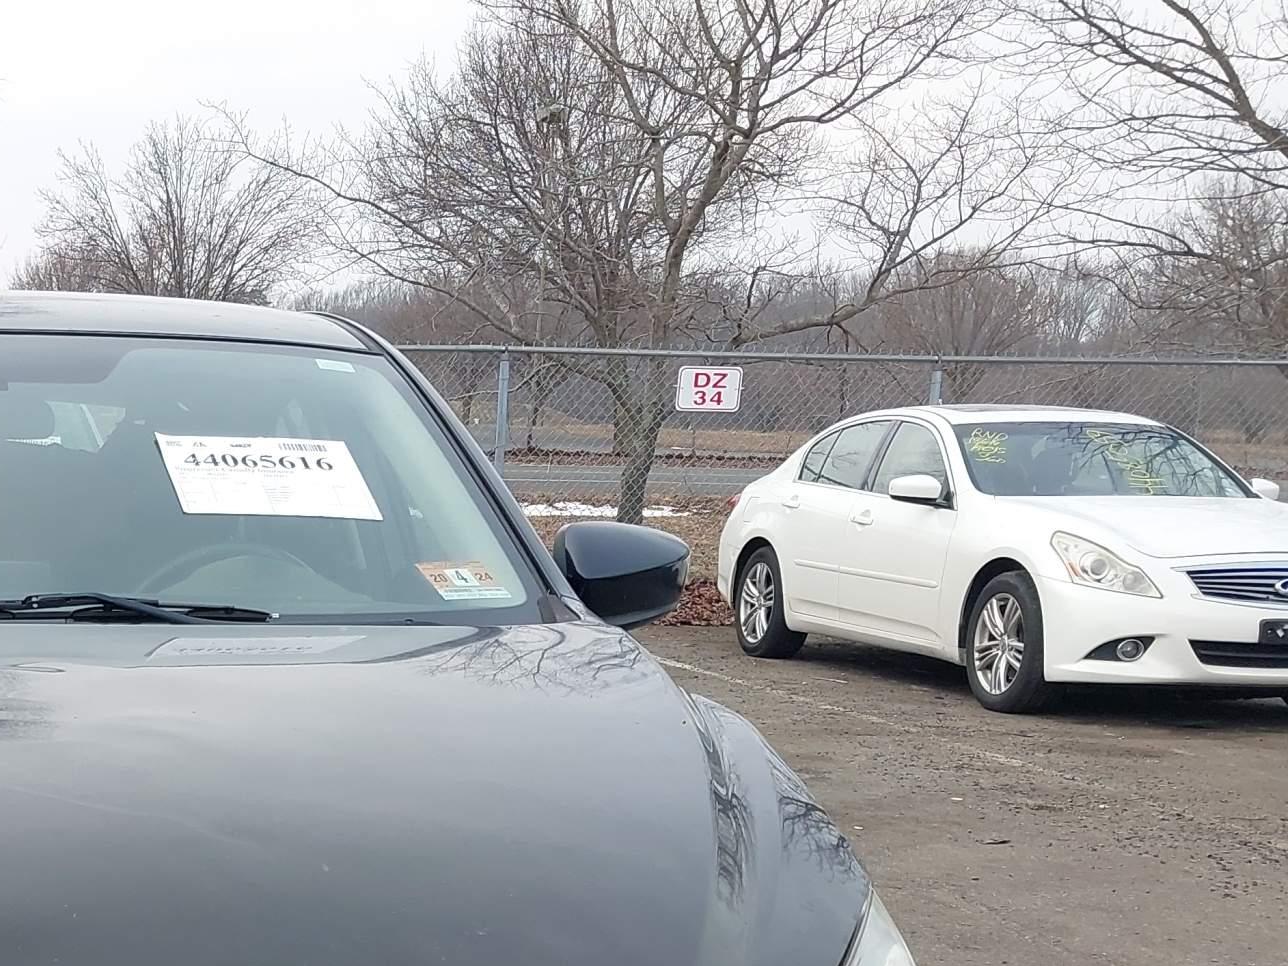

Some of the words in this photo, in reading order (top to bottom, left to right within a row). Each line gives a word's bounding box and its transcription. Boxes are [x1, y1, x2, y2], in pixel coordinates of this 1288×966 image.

[694, 372, 728, 388] DZ
[693, 391, 723, 406] 34
[184, 453, 334, 472] 44065616
[455, 570, 469, 583] 4
